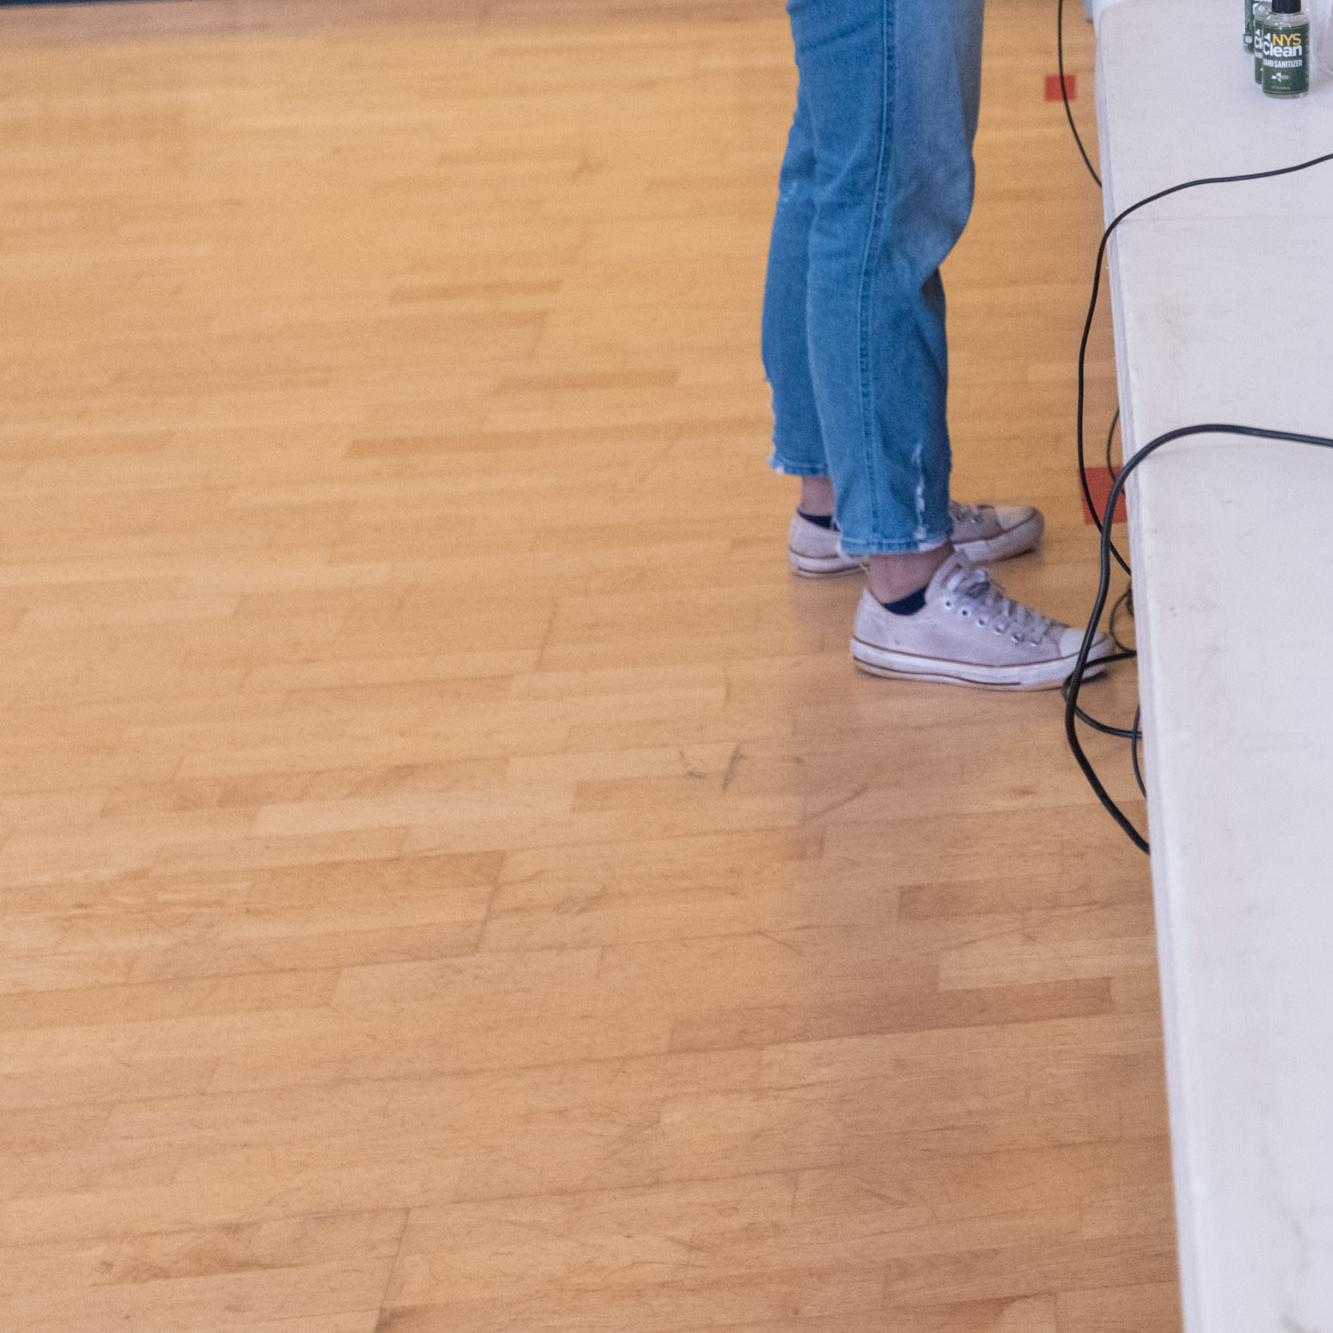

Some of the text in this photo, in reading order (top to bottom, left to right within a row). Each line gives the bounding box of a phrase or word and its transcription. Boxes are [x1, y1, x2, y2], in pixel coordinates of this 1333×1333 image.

[1272, 33, 1302, 47] NYS
[1263, 41, 1302, 57] Clean
[1275, 60, 1303, 68] SANITIZER
